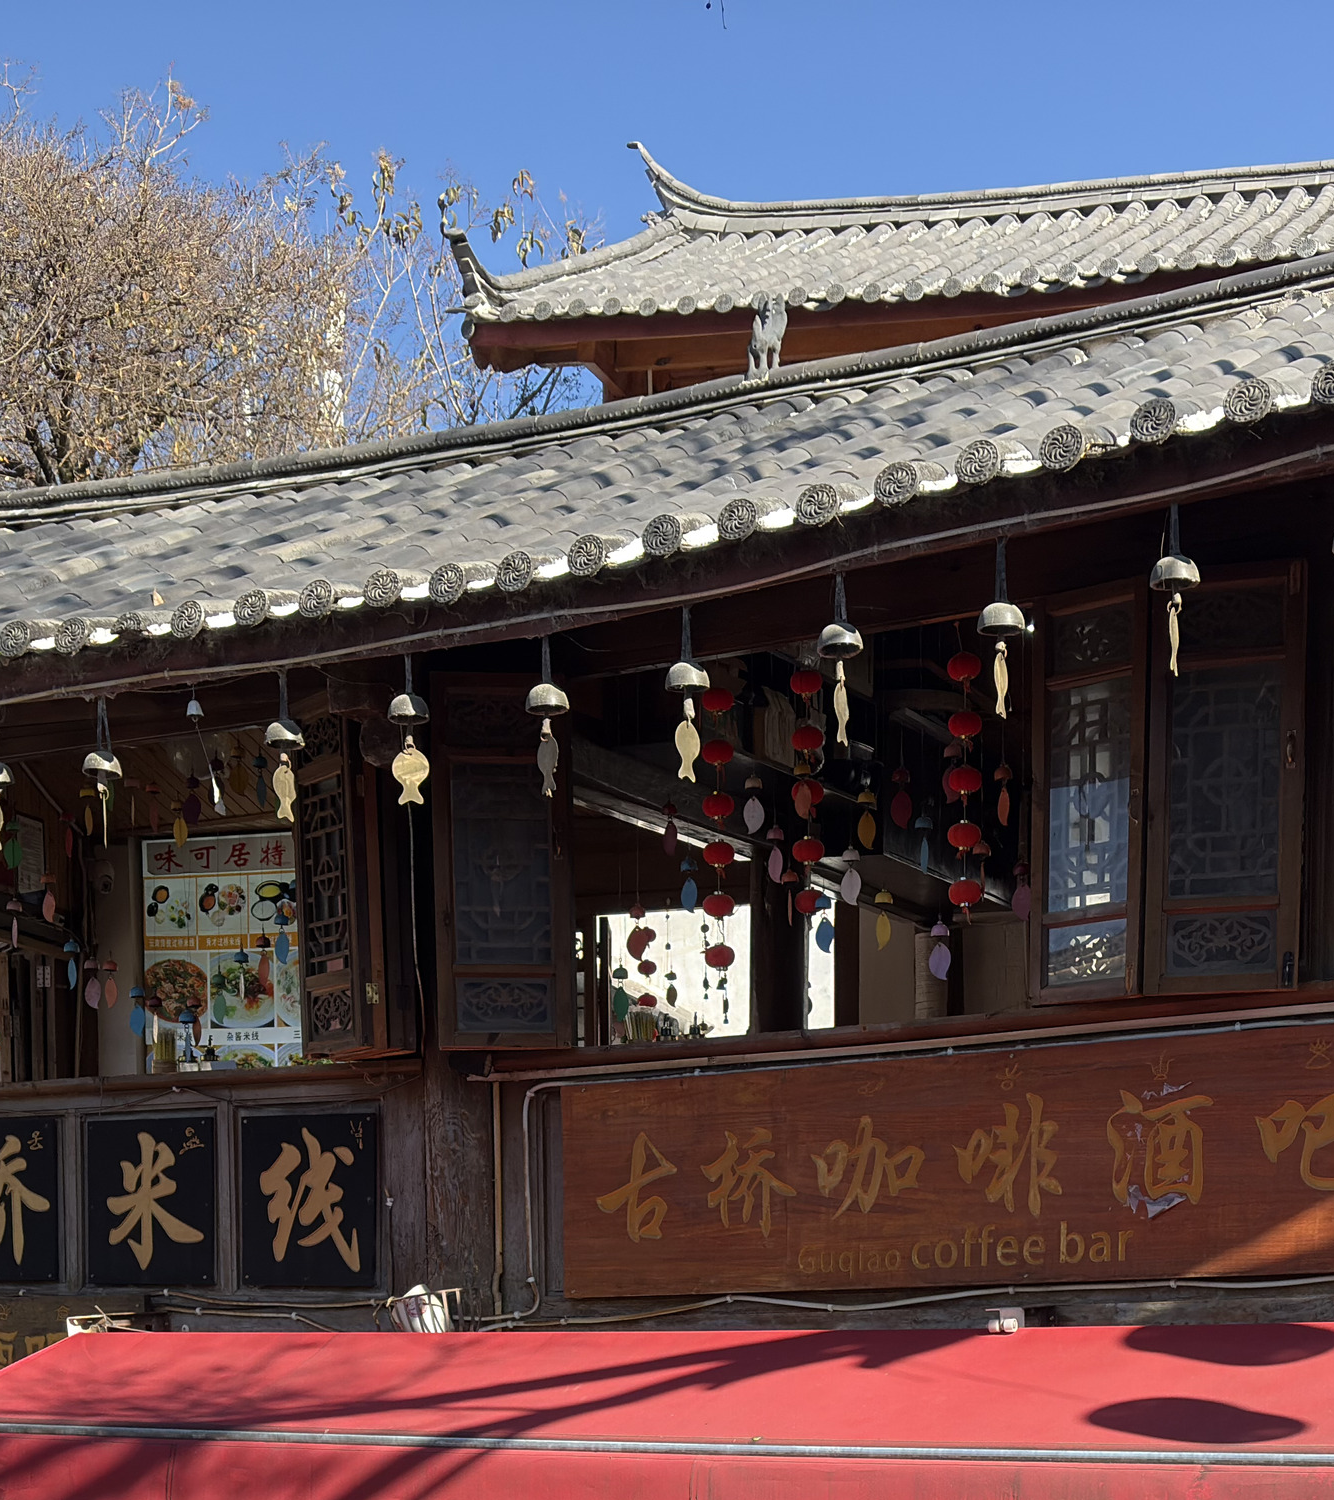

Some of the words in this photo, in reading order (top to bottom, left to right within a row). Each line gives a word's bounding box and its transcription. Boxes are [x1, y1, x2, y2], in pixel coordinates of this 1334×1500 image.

[226, 1031, 260, 1042] 杂酱米线
[798, 1244, 902, 1278] Guqiao
[911, 1224, 1045, 1270] coffee
[1058, 1221, 1134, 1265] bar
